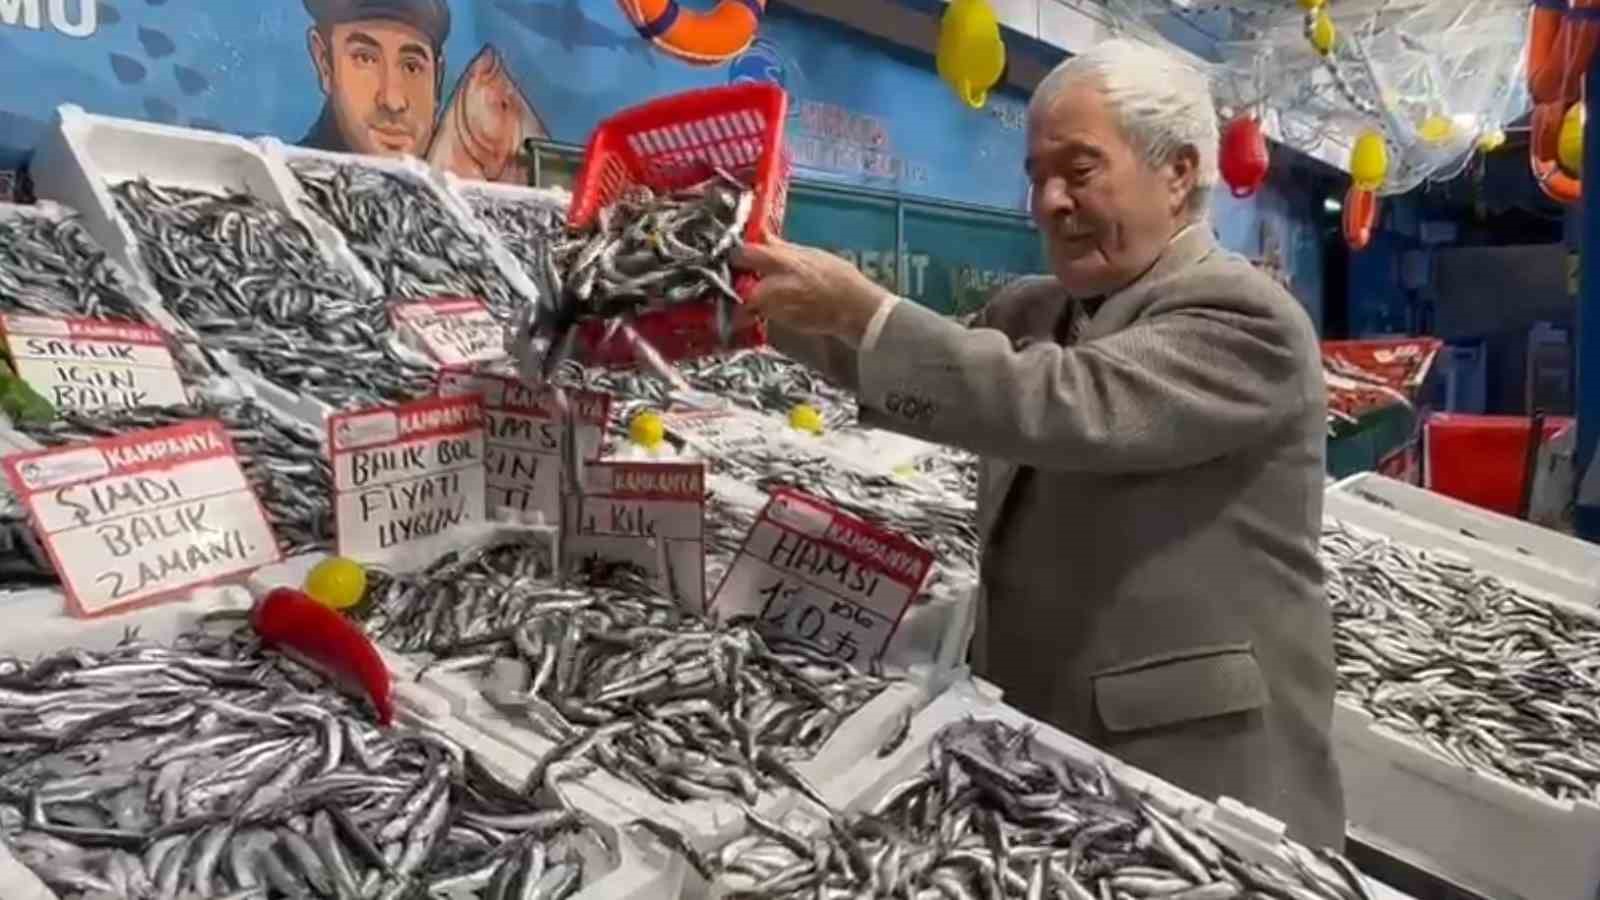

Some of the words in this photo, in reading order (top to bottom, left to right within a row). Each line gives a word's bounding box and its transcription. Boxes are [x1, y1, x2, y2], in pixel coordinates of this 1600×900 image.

[104, 429, 225, 469] KAMPANYA
[352, 445, 426, 486] BALIK
[437, 440, 476, 465] BOL
[96, 503, 220, 557] BALIK
[828, 522, 923, 580] KAMPANYA
